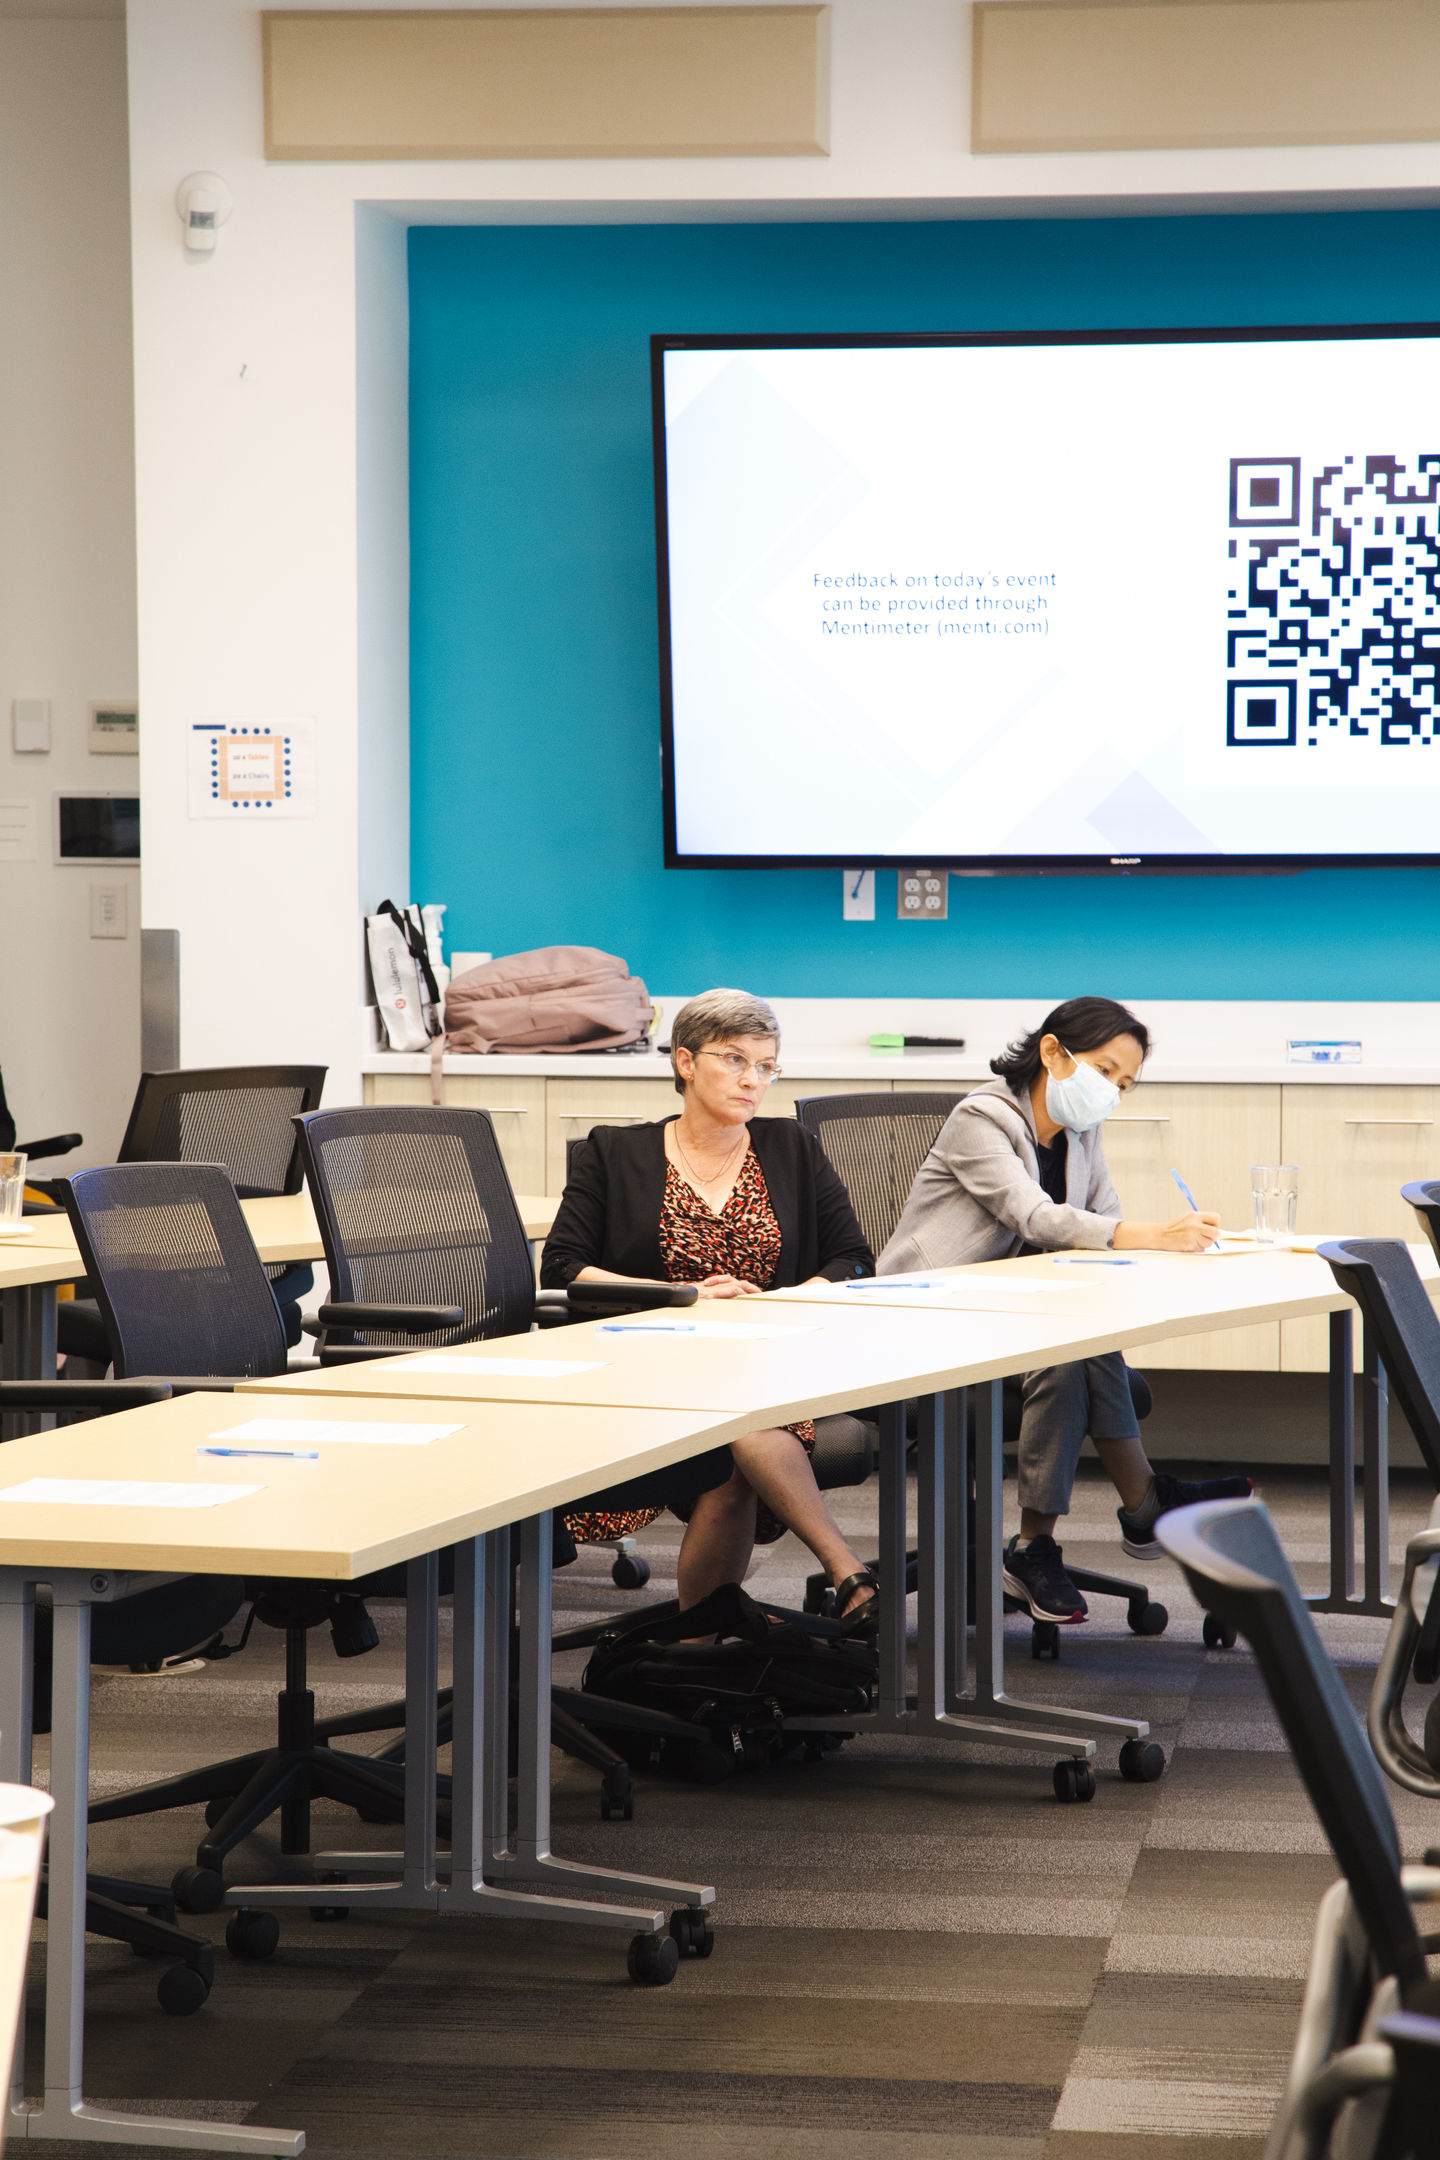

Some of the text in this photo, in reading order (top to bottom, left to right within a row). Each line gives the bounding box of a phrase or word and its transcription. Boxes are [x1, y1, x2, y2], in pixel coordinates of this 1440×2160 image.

[813, 571, 1057, 590] Feedback on today's event
[822, 595, 1048, 614] can be provided through
[821, 618, 1049, 637] Mentimeter (menti.com)
[387, 947, 404, 996] lululemon
